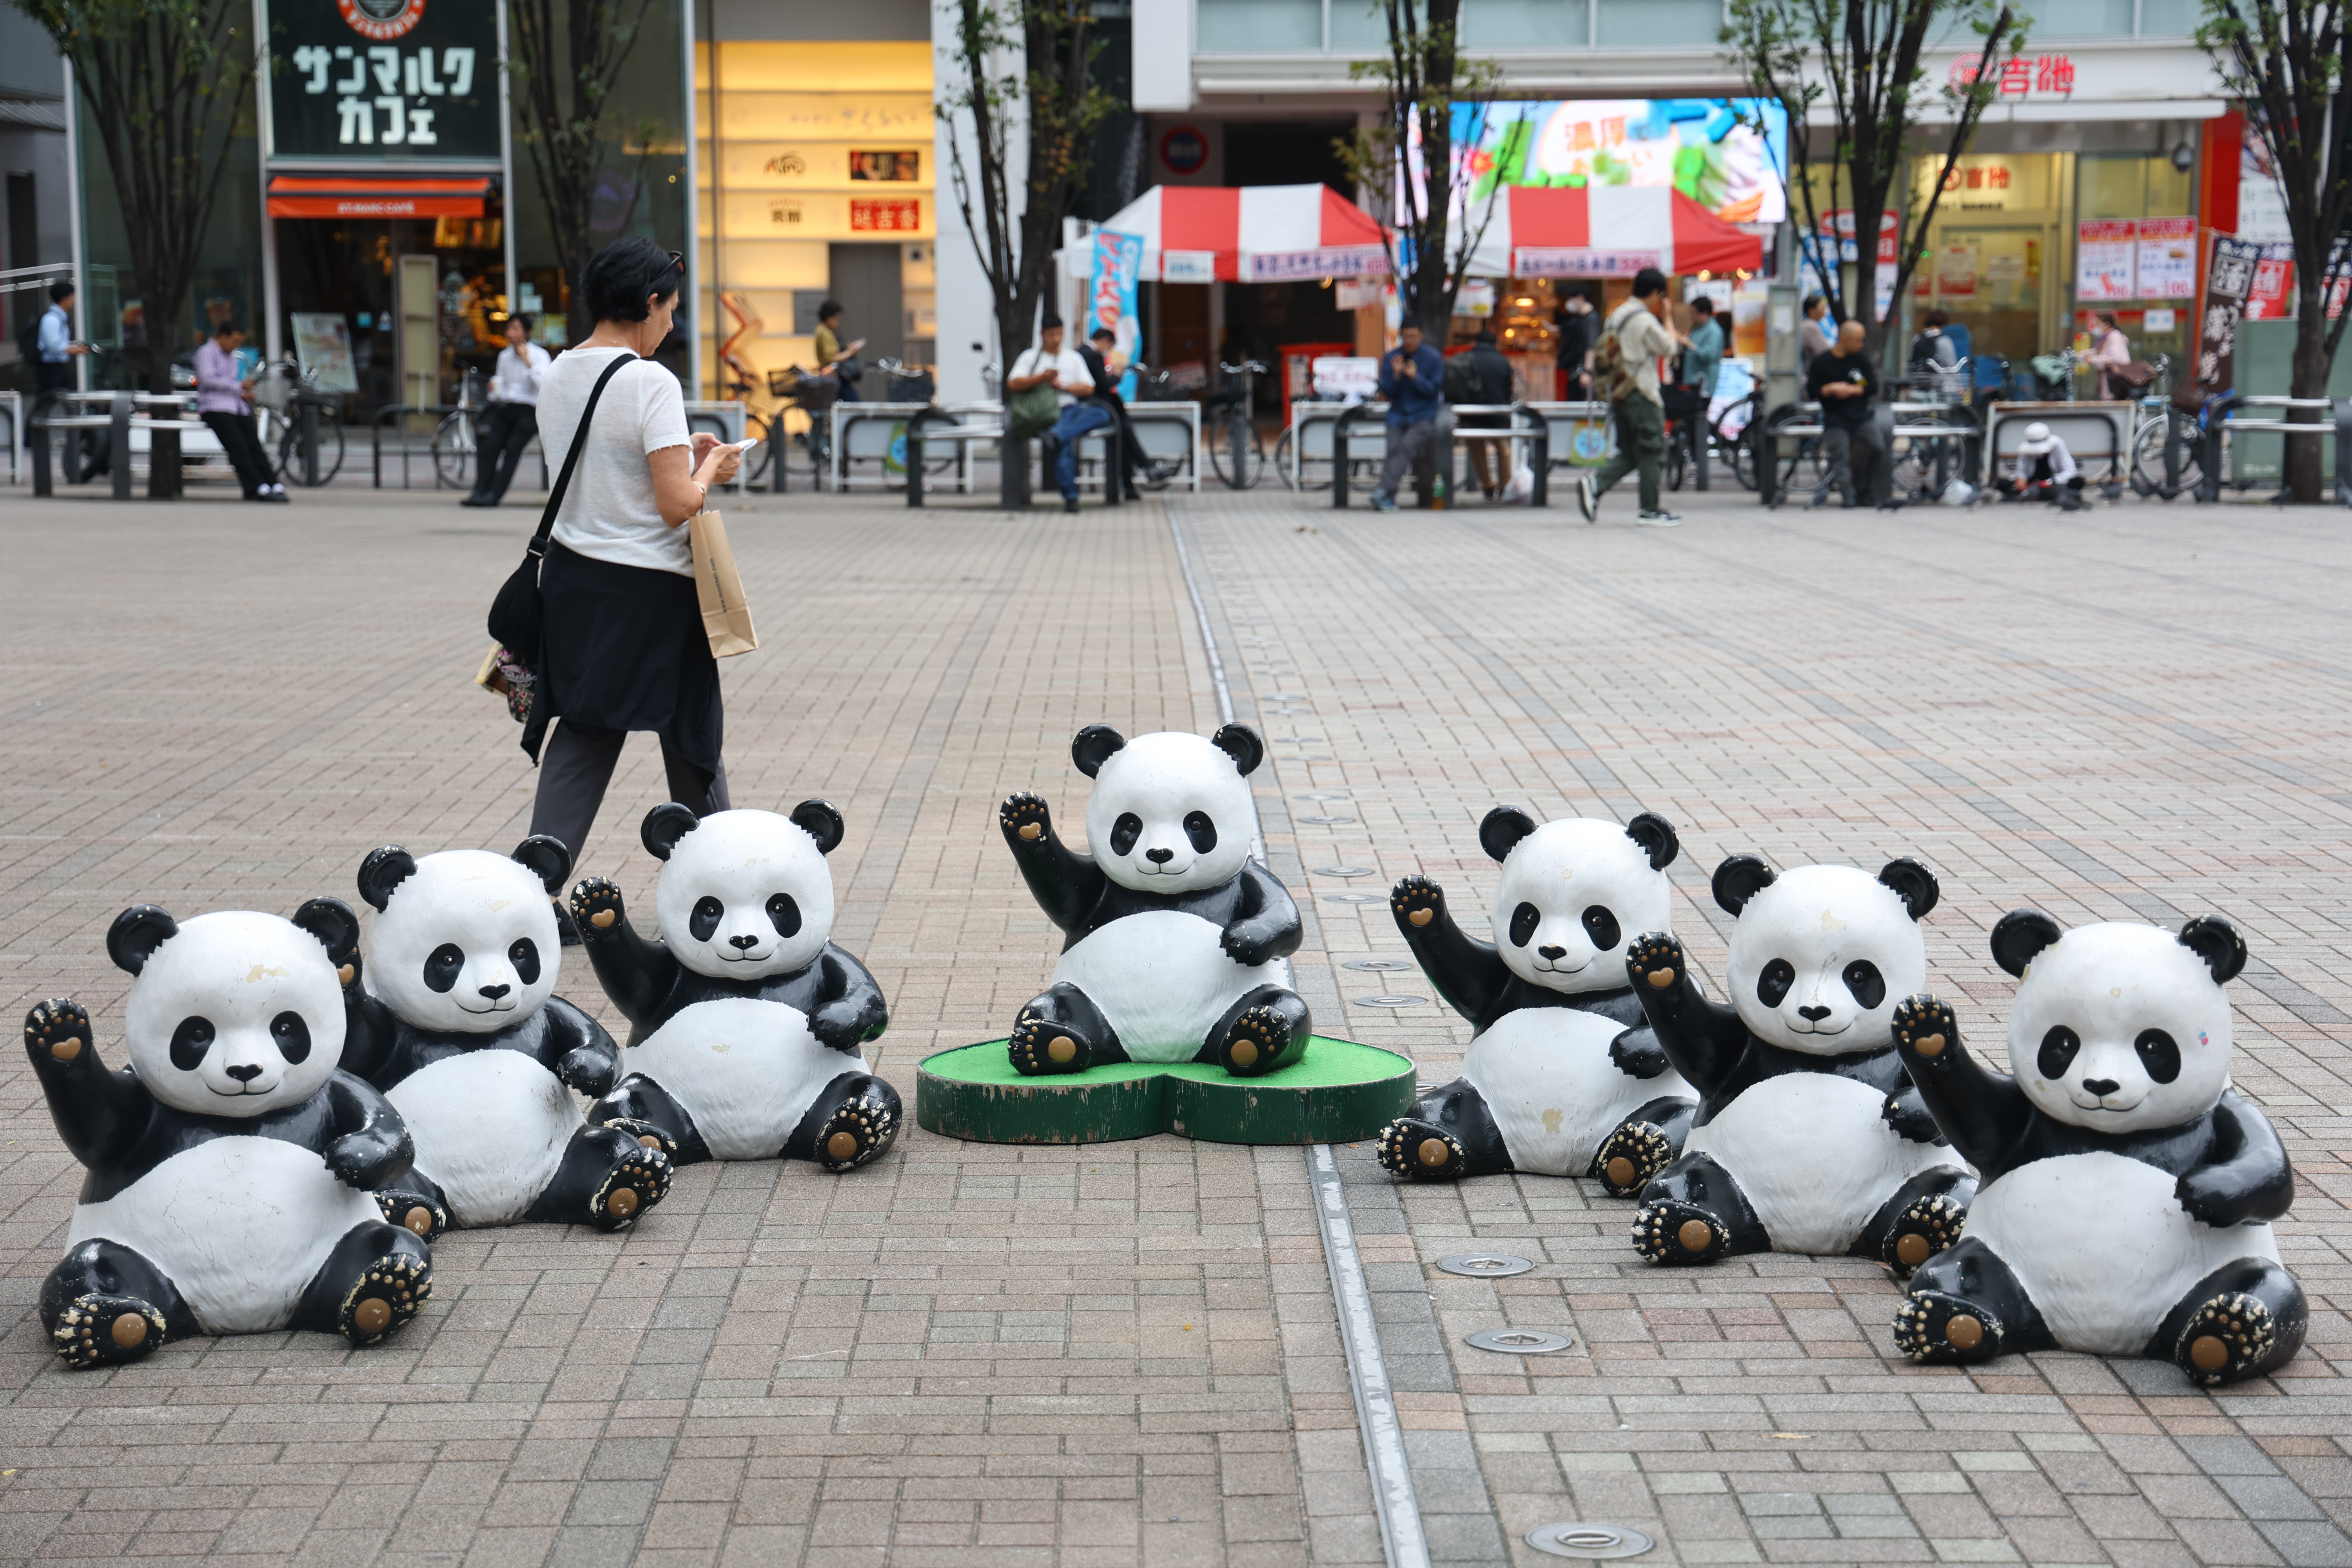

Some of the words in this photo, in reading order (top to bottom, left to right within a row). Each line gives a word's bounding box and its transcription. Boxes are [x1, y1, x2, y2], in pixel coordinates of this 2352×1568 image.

[293, 45, 475, 96] サンマルク
[2000, 54, 2075, 92] 吉池
[336, 94, 438, 145] カフェ
[709, 557, 727, 613] www.montbell.com
